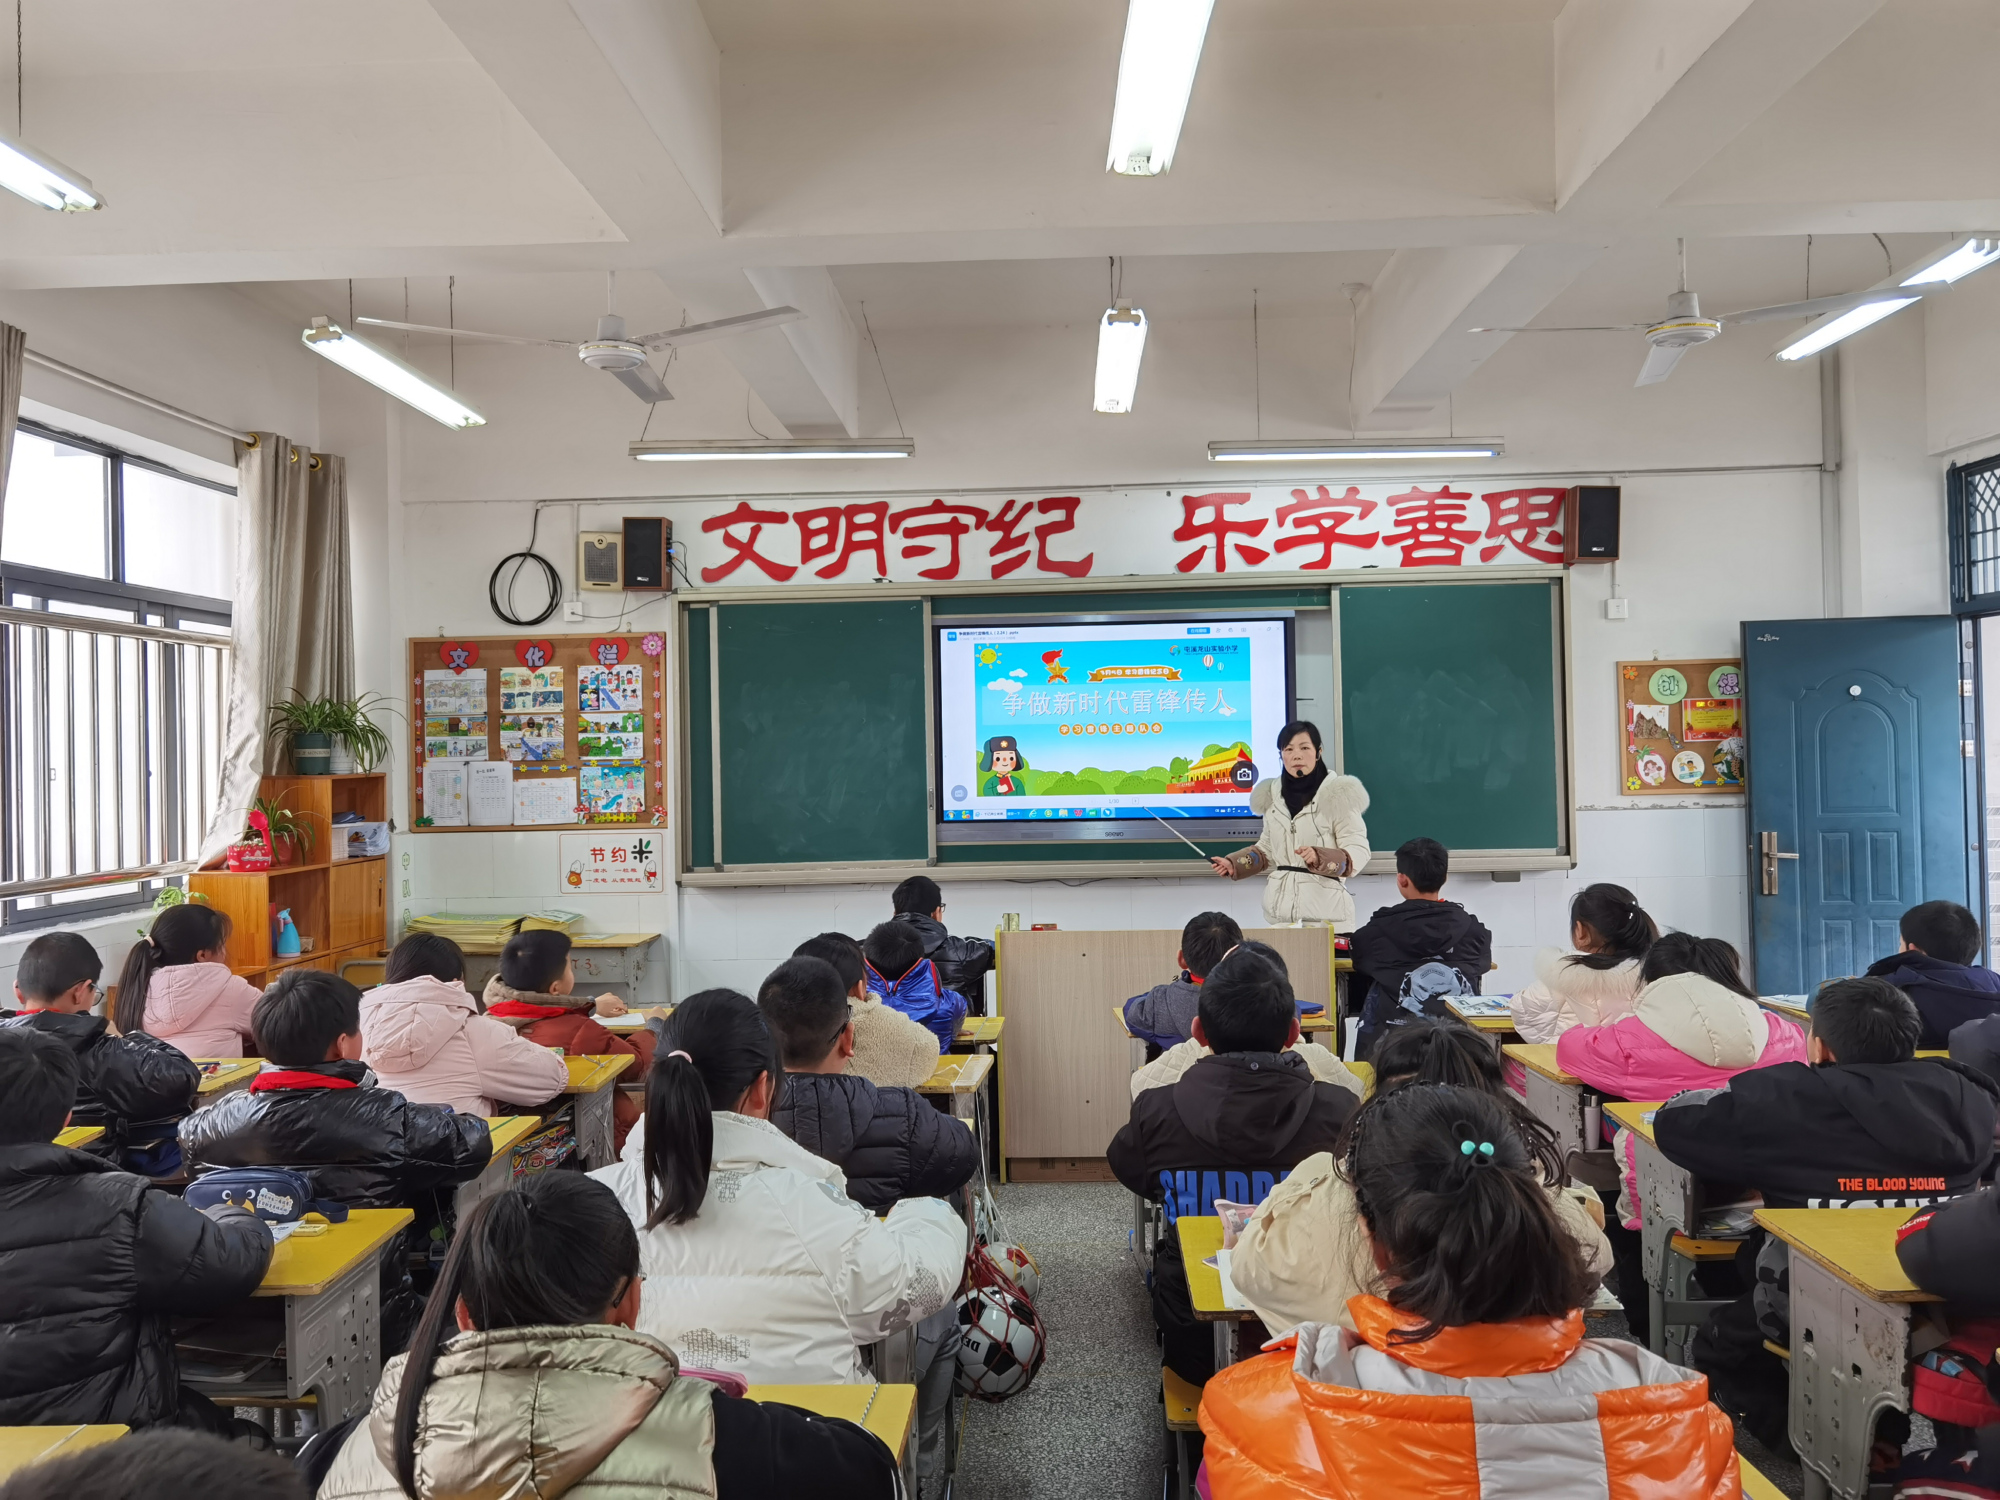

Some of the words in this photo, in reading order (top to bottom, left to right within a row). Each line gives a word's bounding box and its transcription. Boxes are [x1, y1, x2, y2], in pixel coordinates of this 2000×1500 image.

[702, 497, 1093, 582] 文明守纪
[1174, 486, 1565, 572] 乐学善思
[449, 644, 618, 669] 文化栏
[1002, 687, 1234, 717] 争做新时代雷锋传人
[1059, 723, 1163, 735] 学习雷锋主题队会
[590, 847, 627, 864] 节约
[1838, 1178, 1863, 1191] THE
[1866, 1178, 1907, 1191] BLOOD
[1909, 1177, 1946, 1190] YOUNG
